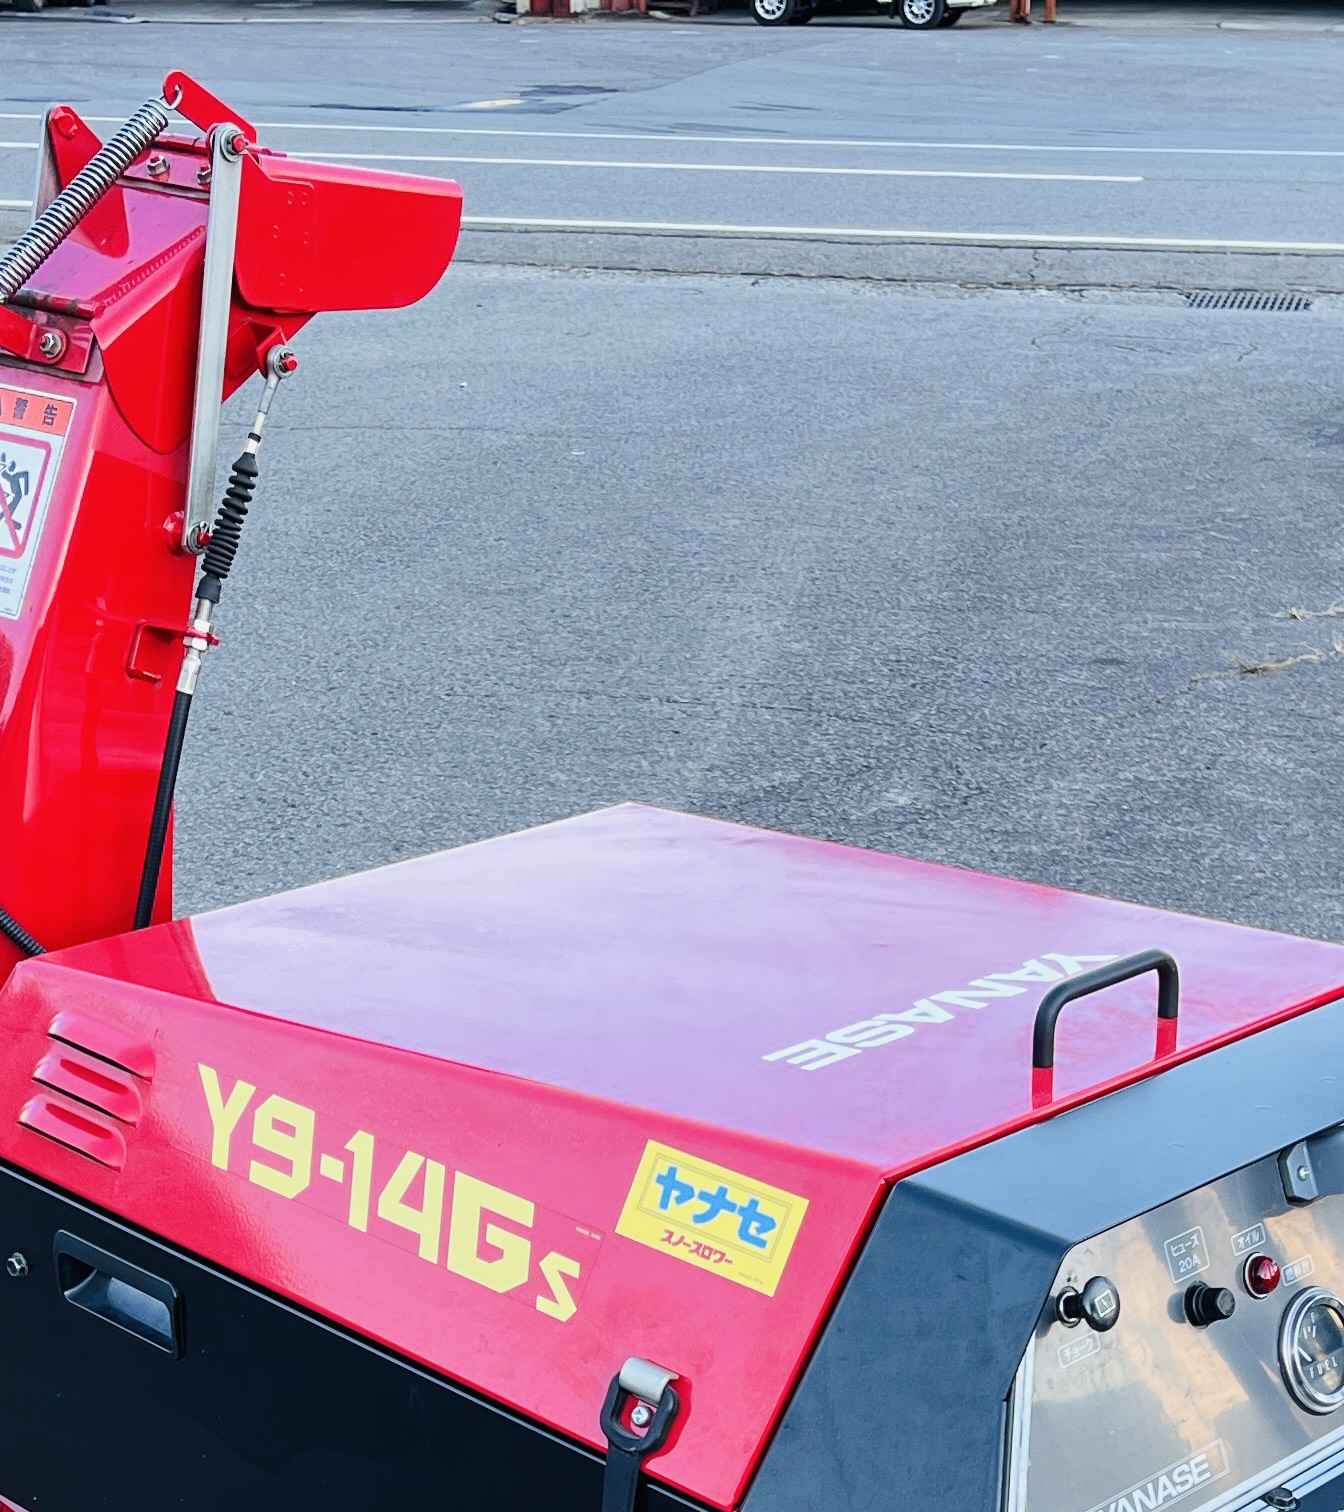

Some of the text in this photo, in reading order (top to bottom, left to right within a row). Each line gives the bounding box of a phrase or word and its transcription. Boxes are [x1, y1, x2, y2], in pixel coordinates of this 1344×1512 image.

[12, 397, 58, 426] 警告
[761, 952, 1119, 1071] YANASE
[655, 1165, 778, 1250] ヤナセ
[659, 1228, 734, 1266] スノースロワー
[1235, 1229, 1261, 1250] オイル
[1177, 1256, 1202, 1275] 20A
[1062, 1339, 1095, 1361] チョーク
